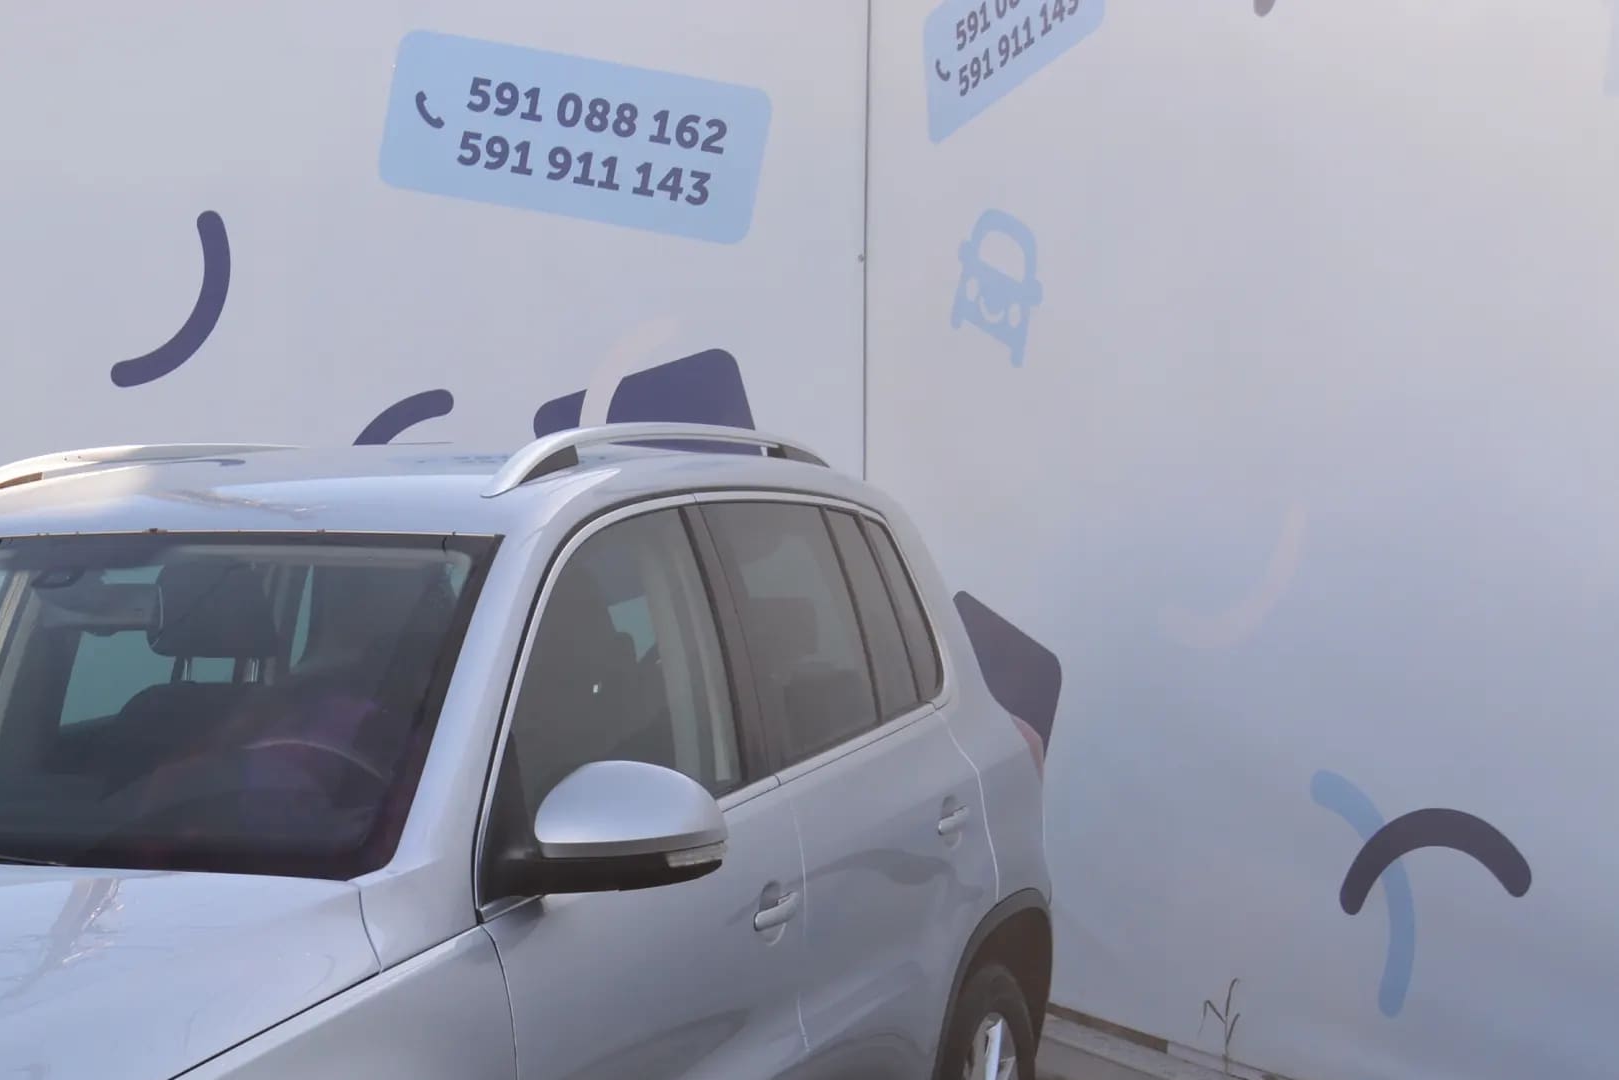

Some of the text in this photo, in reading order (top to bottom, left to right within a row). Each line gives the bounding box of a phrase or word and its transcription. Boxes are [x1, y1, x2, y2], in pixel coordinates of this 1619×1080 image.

[955, 2, 991, 51] 591
[958, 48, 994, 97] 591
[998, 16, 1035, 68] 911
[466, 76, 728, 155] 591 088 162
[456, 130, 712, 206] 591 911 143
